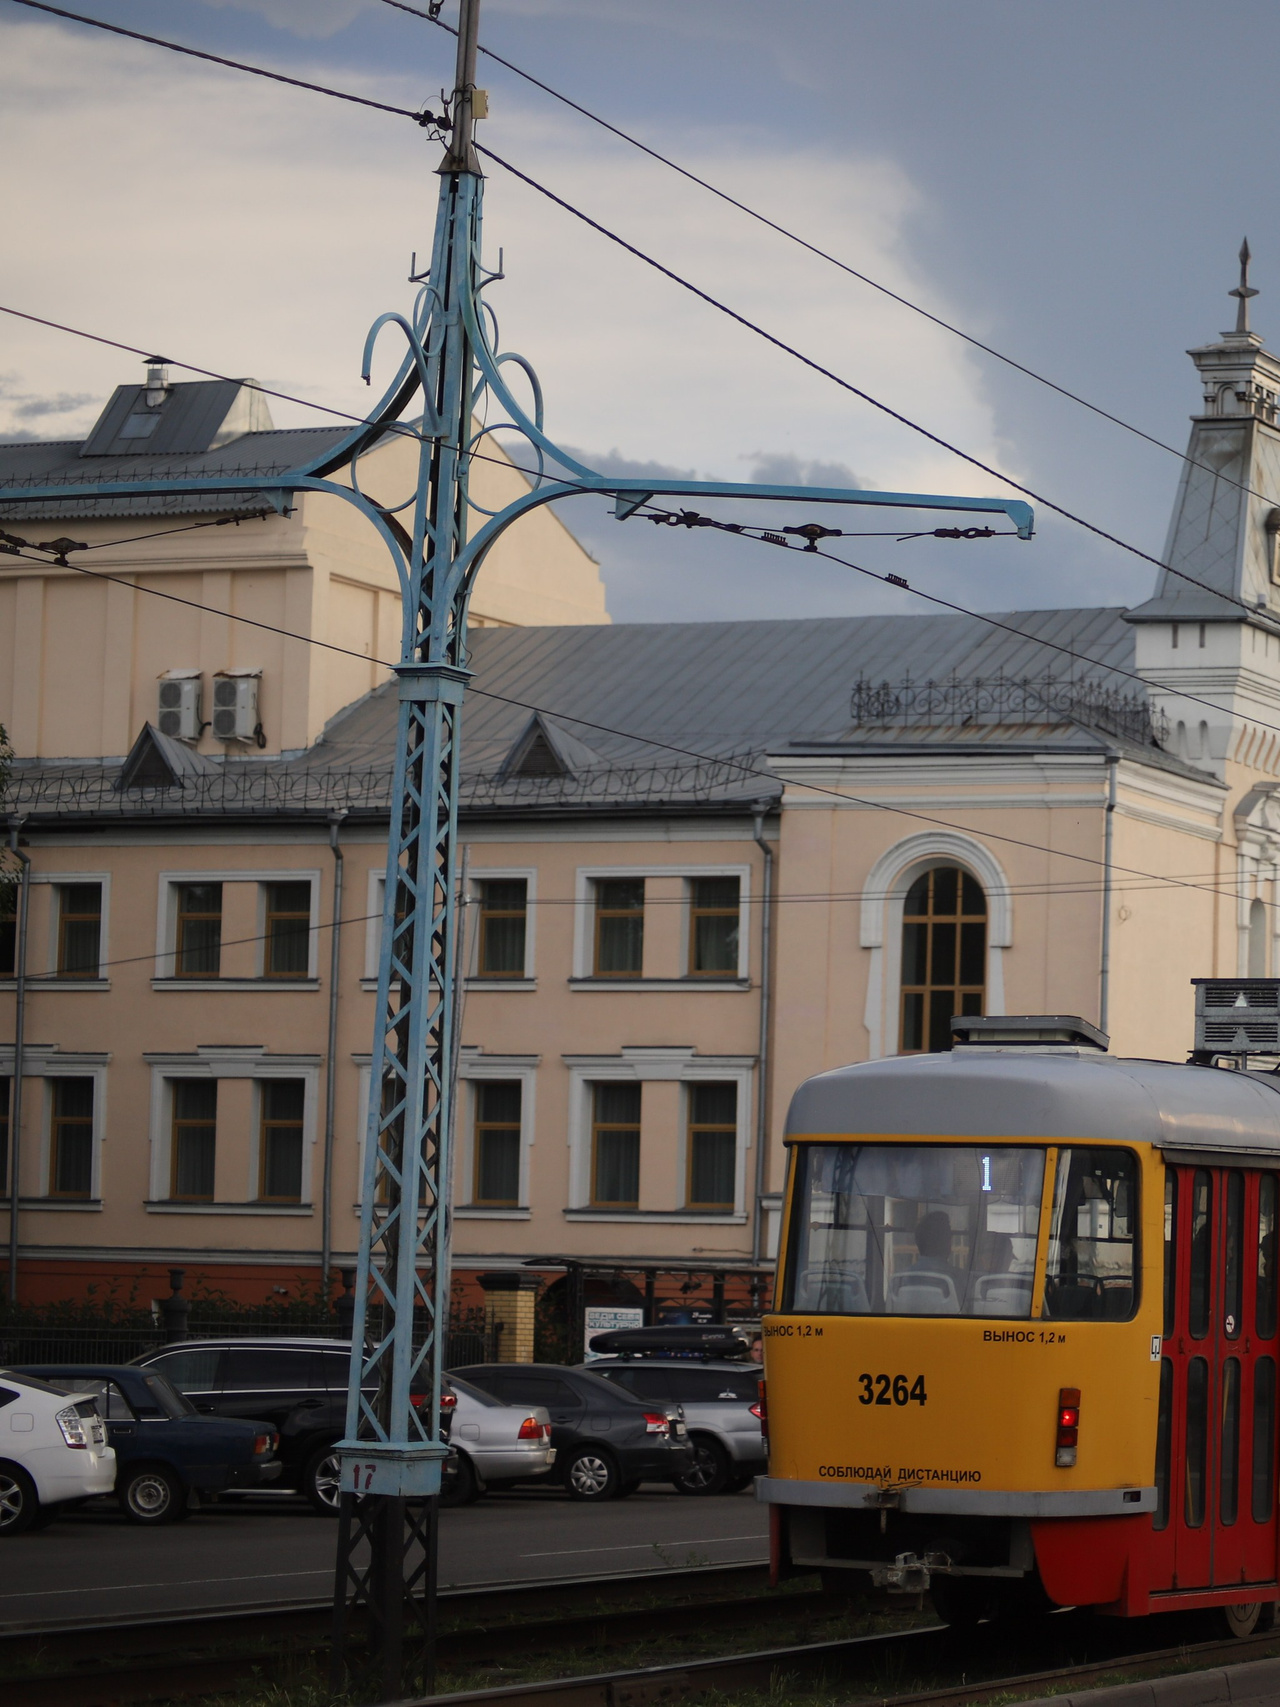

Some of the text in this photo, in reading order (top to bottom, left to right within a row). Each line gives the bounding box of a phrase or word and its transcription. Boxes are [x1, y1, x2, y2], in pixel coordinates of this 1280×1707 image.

[982, 1156, 992, 1191] 1
[797, 1325, 812, 1338] 1,2
[815, 1327, 824, 1336] м
[983, 1330, 1066, 1345] ВЫНОС 1,2 м
[858, 1373, 928, 1407] 3264
[353, 1464, 377, 1490] 17
[818, 1465, 982, 1483] СОБЛЮДАЙ ДИСТАНЦИЮ
